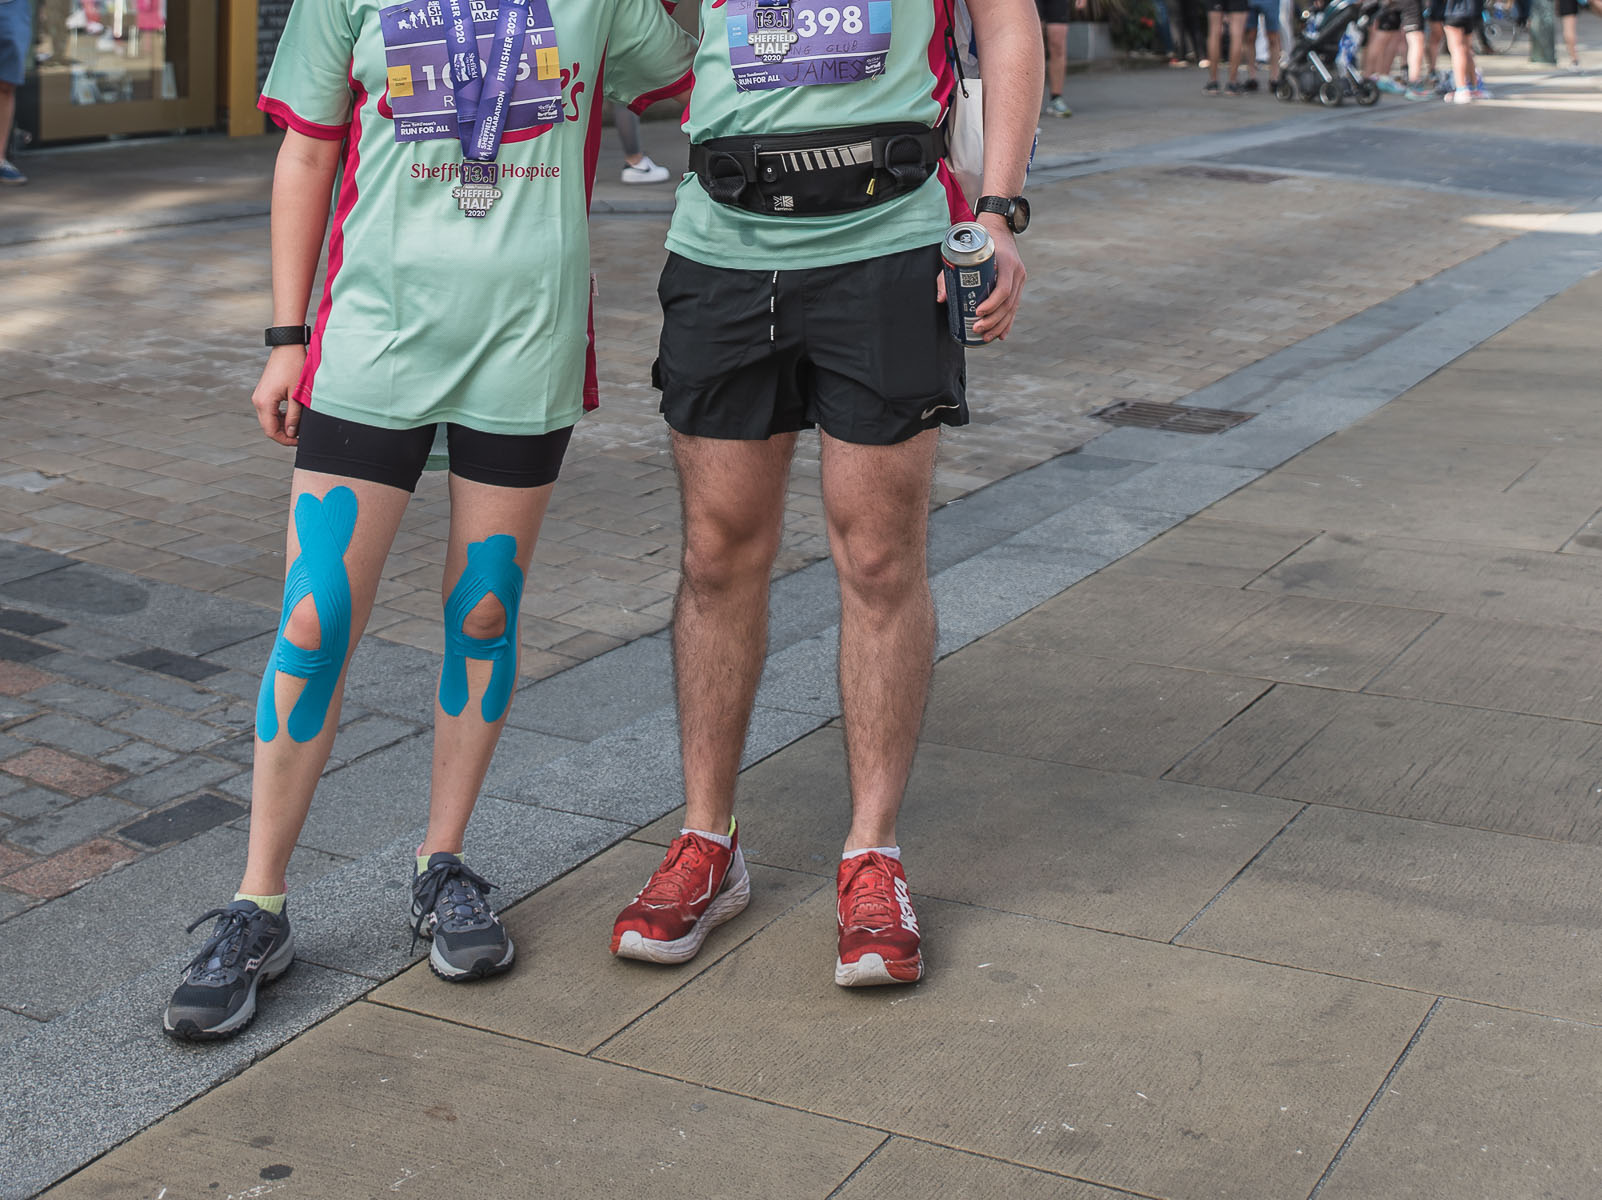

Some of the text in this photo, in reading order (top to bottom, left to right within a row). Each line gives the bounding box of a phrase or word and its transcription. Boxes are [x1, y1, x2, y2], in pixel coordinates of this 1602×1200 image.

[756, 11, 790, 29] 13.1
[453, 19, 465, 44] 2020
[748, 33, 797, 43] SHEFFIELD
[496, 11, 518, 82] FINISHER 2020
[754, 42, 789, 55] HALF
[762, 54, 782, 62] 2020
[784, 59, 864, 83] JAMES
[739, 74, 781, 86] RUN FOR ALL
[487, 90, 506, 151] HALF MARATHON
[400, 124, 450, 136] RUN FOR ALL
[481, 116, 493, 150] SHEFFIELD
[410, 162, 560, 182] Sheffi Hospice
[463, 165, 497, 183] 13.1
[454, 187, 502, 198] SHEFFIELD
[460, 198, 493, 210] HALF
[467, 209, 486, 217] 2020
